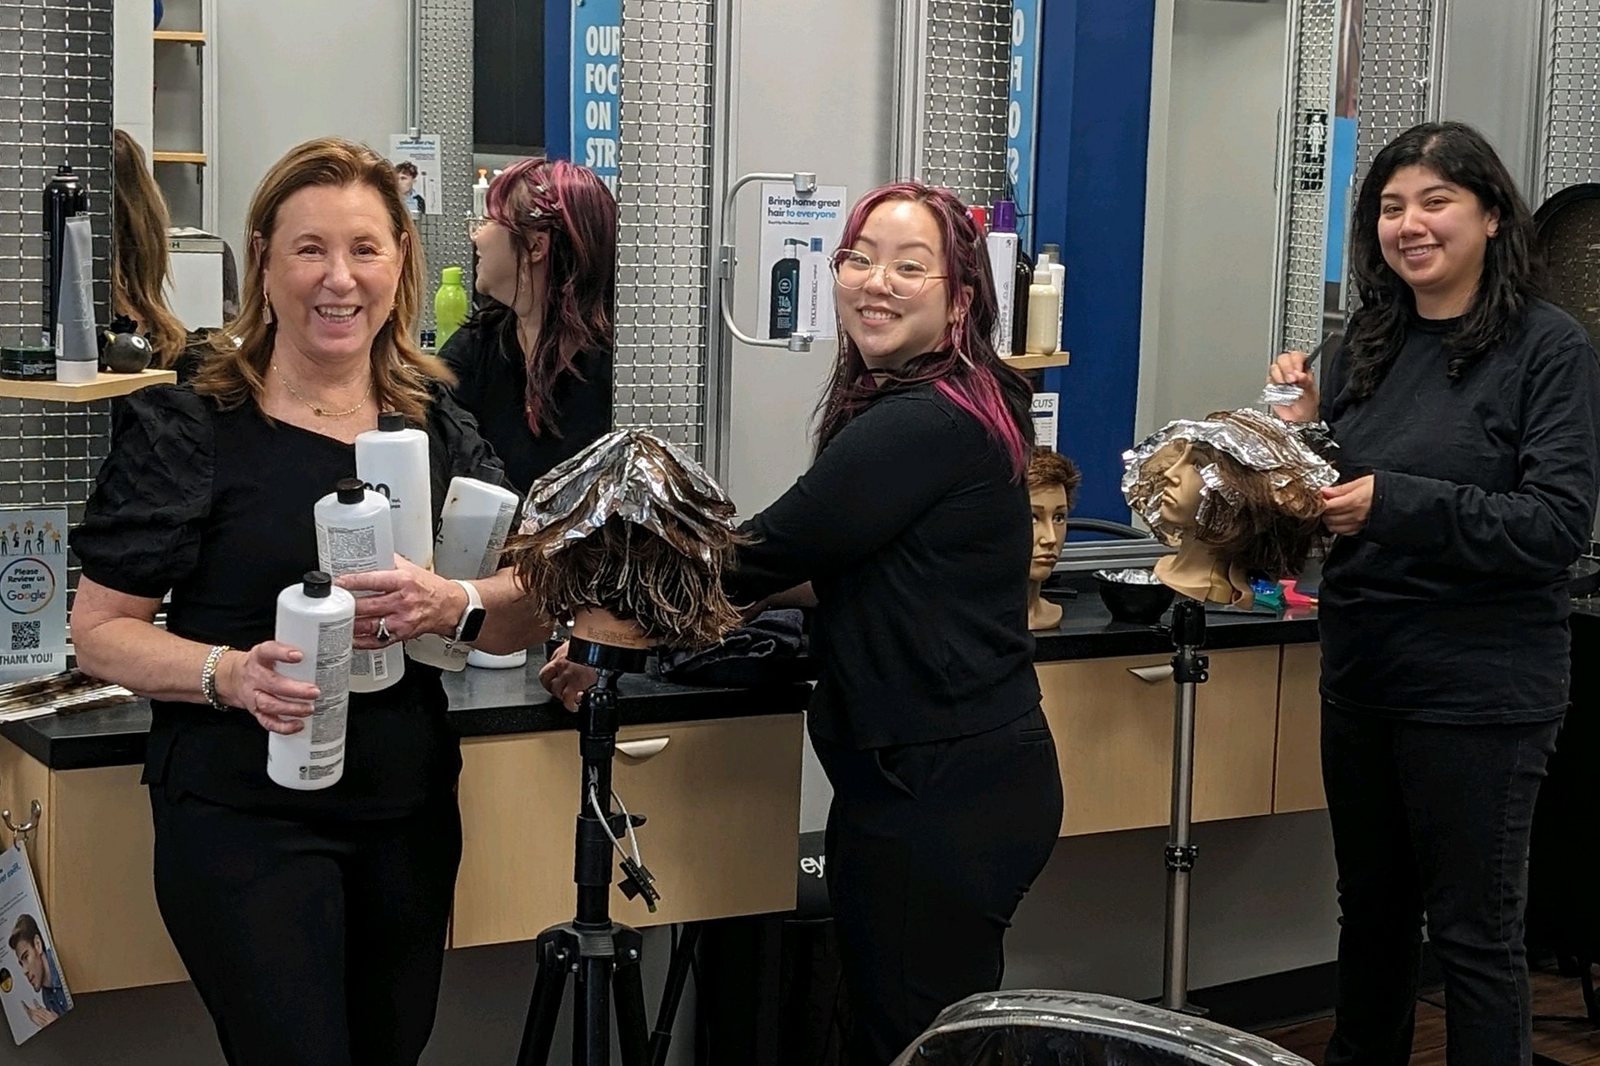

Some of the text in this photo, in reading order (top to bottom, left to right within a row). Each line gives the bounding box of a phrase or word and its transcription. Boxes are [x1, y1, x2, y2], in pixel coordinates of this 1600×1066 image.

[585, 100, 612, 131] ON
[768, 196, 841, 209] Bring home great
[768, 207, 837, 220] hair to everyone
[1033, 399, 1054, 408] CUTS
[8, 575, 35, 583] Review
[7, 589, 46, 602] Google
[0, 652, 53, 665] THANK YOU!
